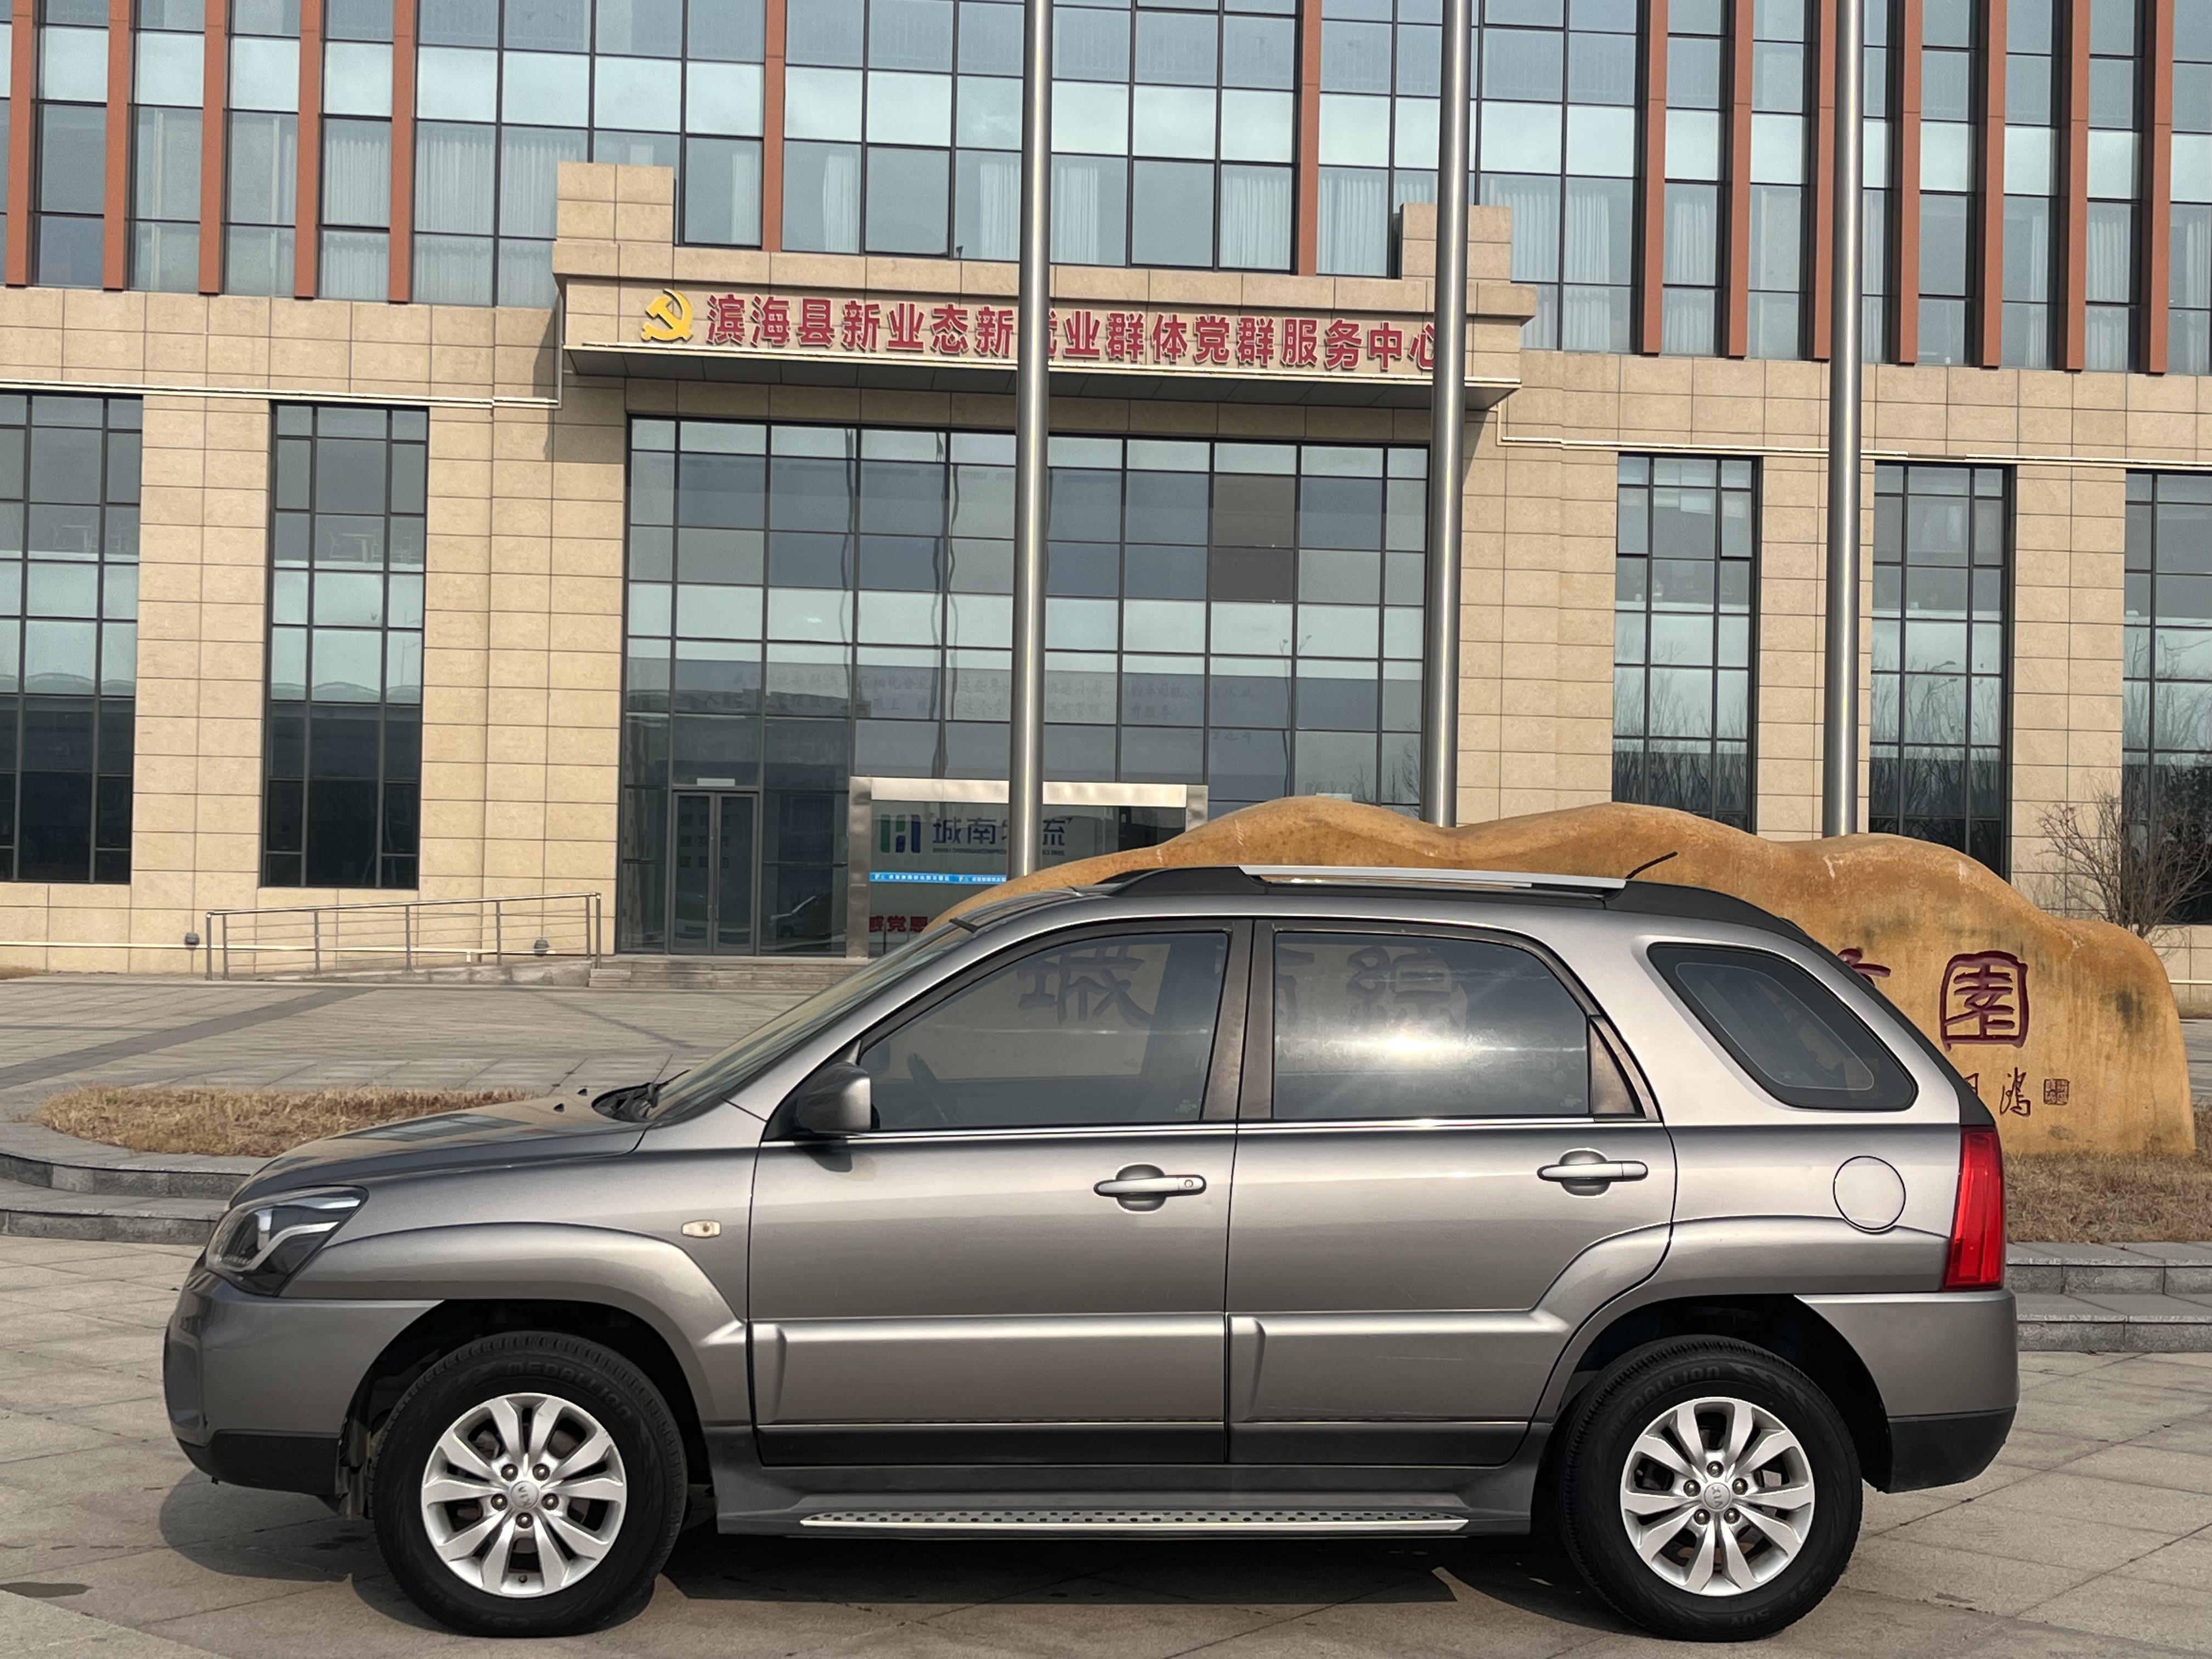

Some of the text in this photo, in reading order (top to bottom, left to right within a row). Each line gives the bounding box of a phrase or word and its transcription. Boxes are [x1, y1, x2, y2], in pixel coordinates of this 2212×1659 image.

[707, 293, 1435, 370] 滨海县新业态新业群体党群服务中心
[932, 817, 1065, 846] 城南流
